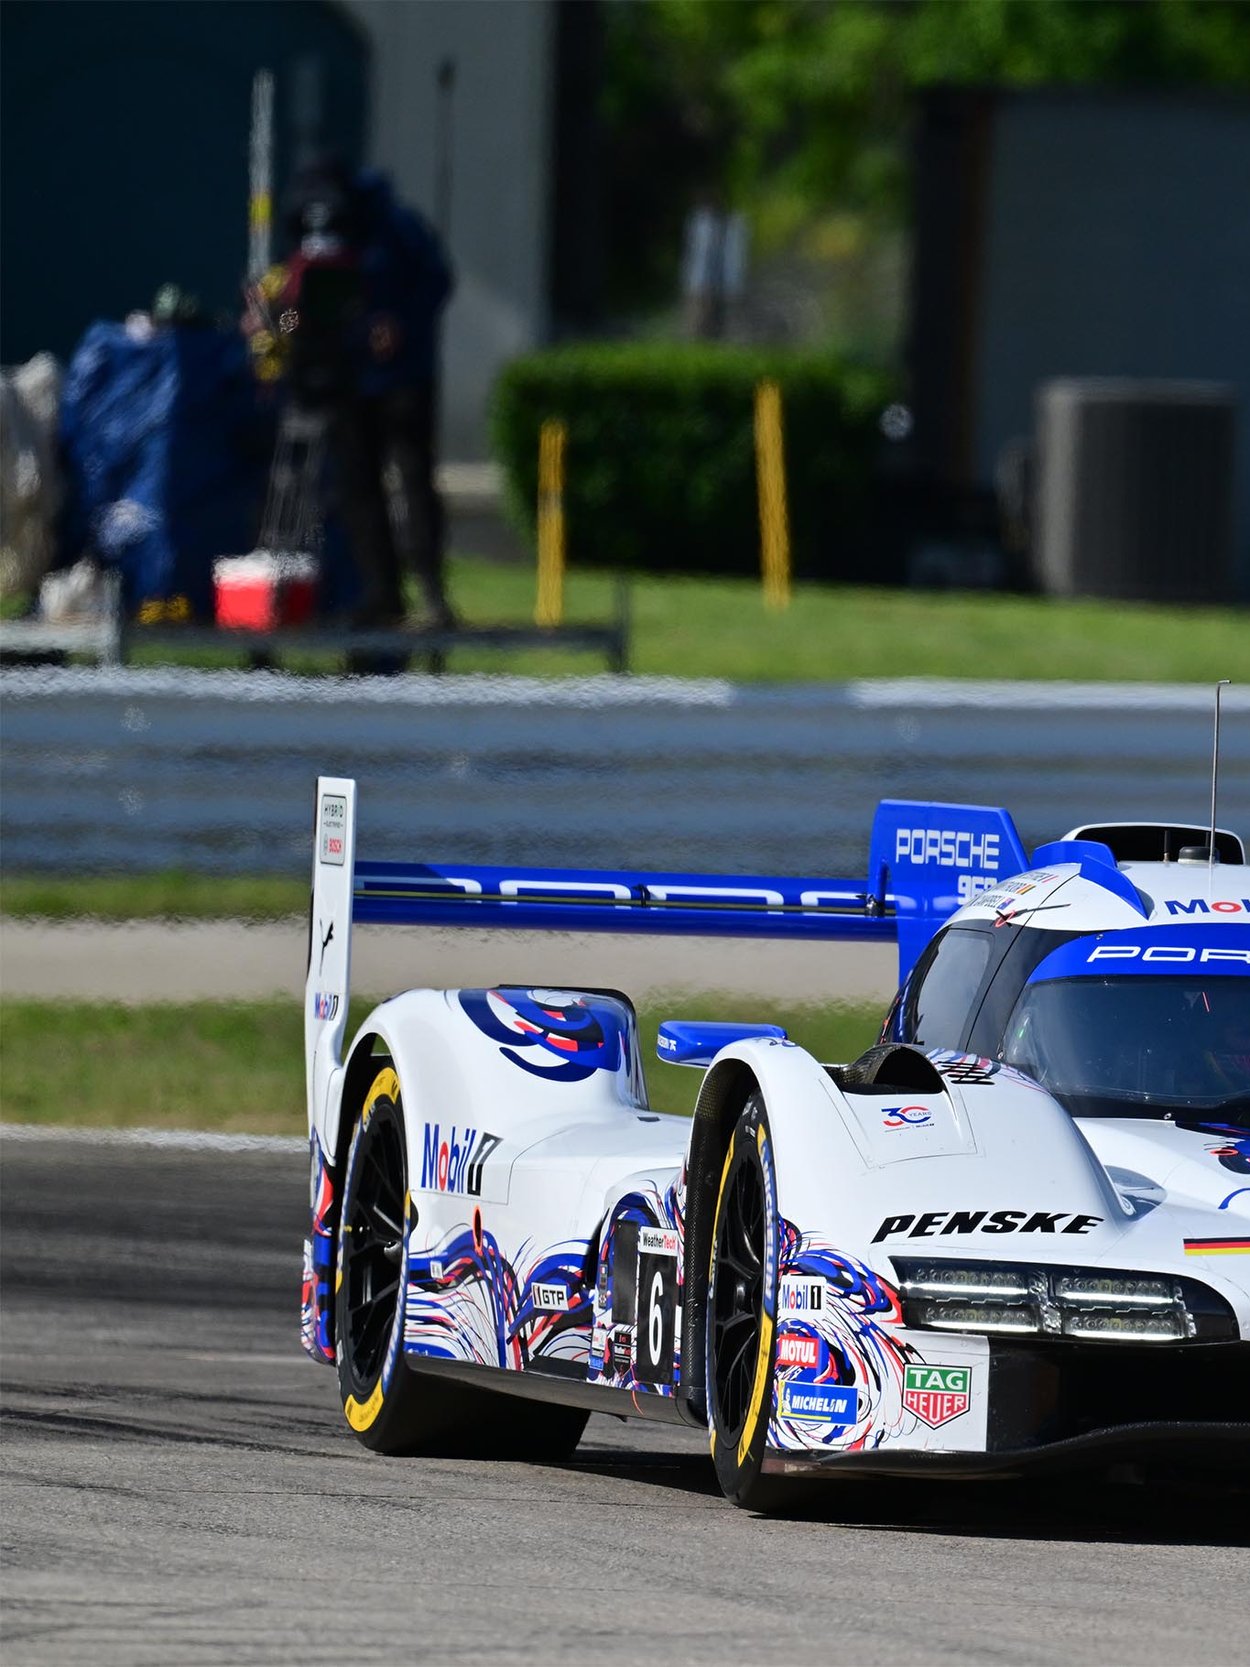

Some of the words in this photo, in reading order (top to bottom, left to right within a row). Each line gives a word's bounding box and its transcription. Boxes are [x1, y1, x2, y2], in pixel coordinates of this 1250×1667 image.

[896, 828, 1000, 870] PORSCHE
[421, 1123, 477, 1194] Mobil
[870, 1211, 1104, 1244] PENSKE
[643, 1232, 677, 1249] WeatherTech
[542, 1290, 565, 1306] GTP
[782, 1285, 808, 1310] Mobil
[649, 1271, 664, 1366] 6
[781, 1339, 816, 1364] MOTUL
[910, 1370, 964, 1390] TAG
[791, 1395, 848, 1413] MICHELIN
[907, 1393, 965, 1423] HEUER
